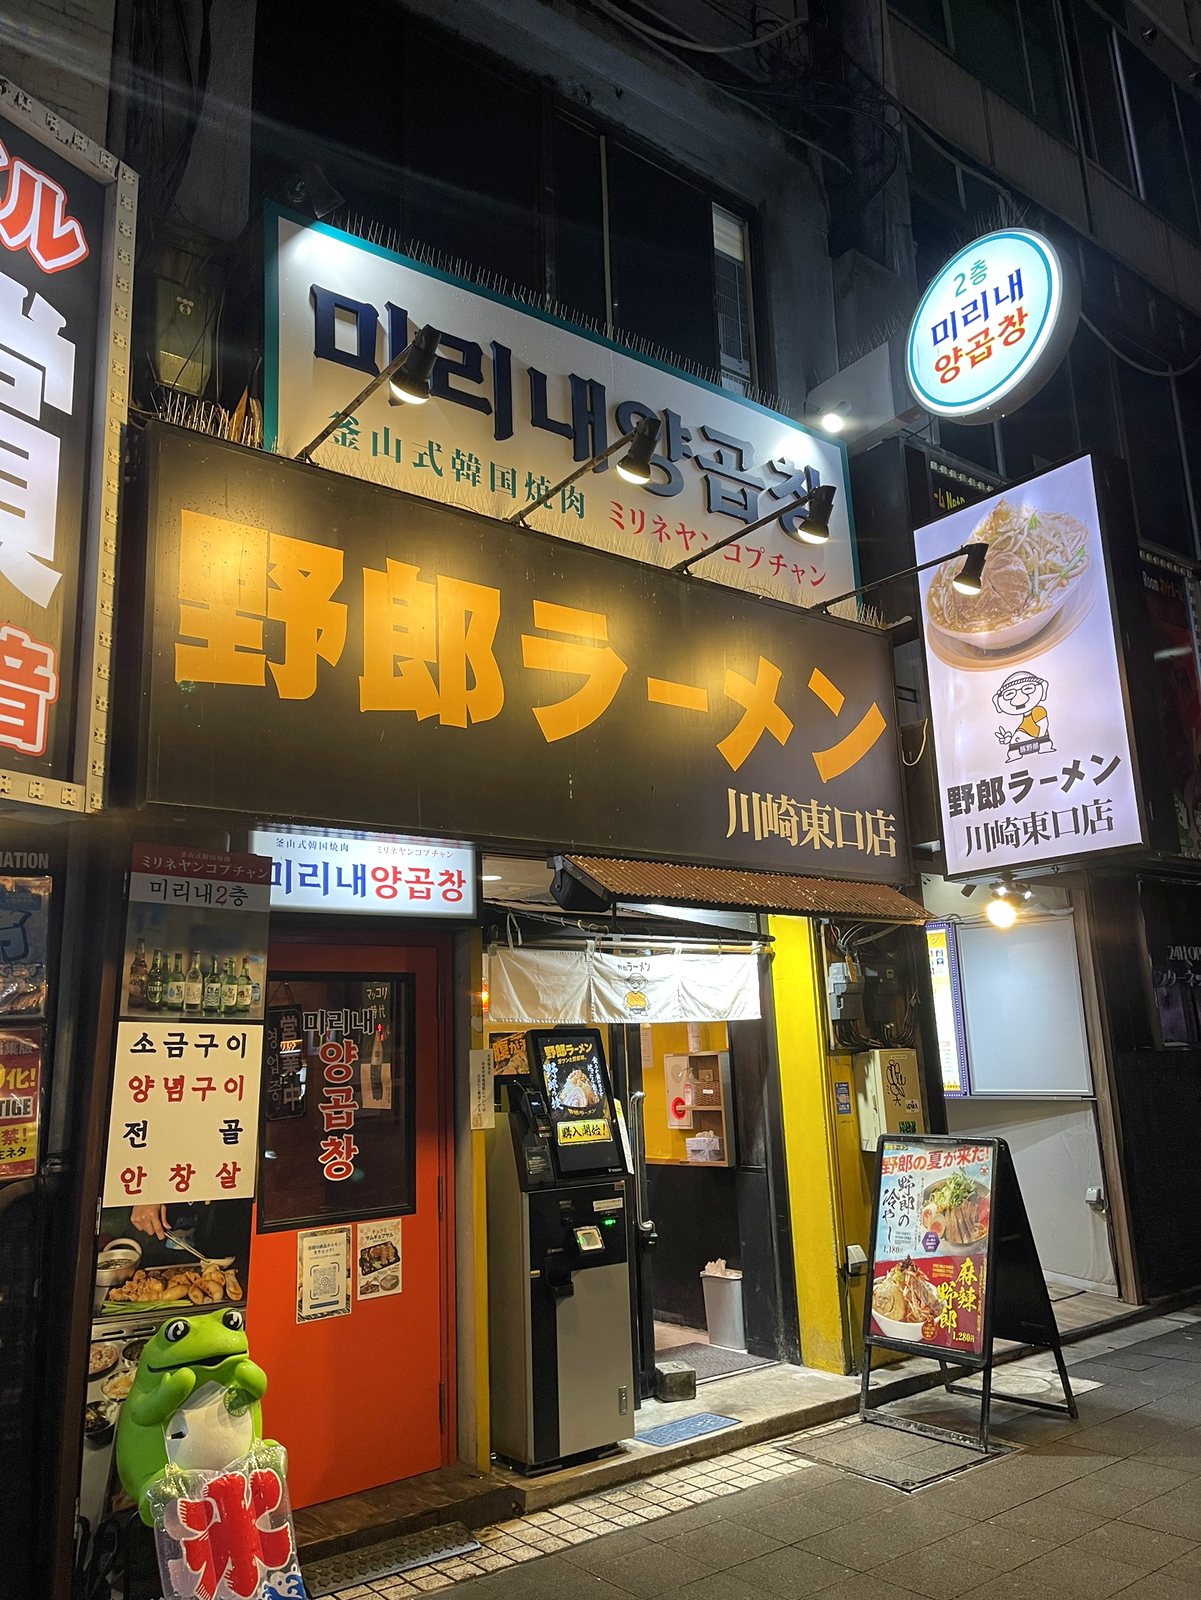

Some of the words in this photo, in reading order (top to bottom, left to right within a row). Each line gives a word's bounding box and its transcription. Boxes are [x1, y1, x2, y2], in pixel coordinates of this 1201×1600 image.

[0, 139, 89, 274] ル
[930, 267, 1024, 348] 미리내
[953, 258, 989, 298] 2층
[934, 306, 1029, 385] 양곱창
[328, 410, 586, 519] 釜山式韓国焼肉
[174, 508, 887, 784] 野郎ラーメン
[947, 754, 1122, 818] 野郎ラーメン
[276, 837, 349, 853] 釜山式韓国焼肉
[727, 788, 897, 859] 川崎東口店
[965, 798, 1114, 858] 川崎東口店
[0, 851, 49, 870] ATION
[142, 855, 268, 880] ミリネヤンコプチャン
[150, 878, 249, 907] 미리내2층
[129, 1032, 247, 1059] 소금구이
[302, 1008, 376, 1036] 미리내
[317, 1038, 359, 1182] 양곱창
